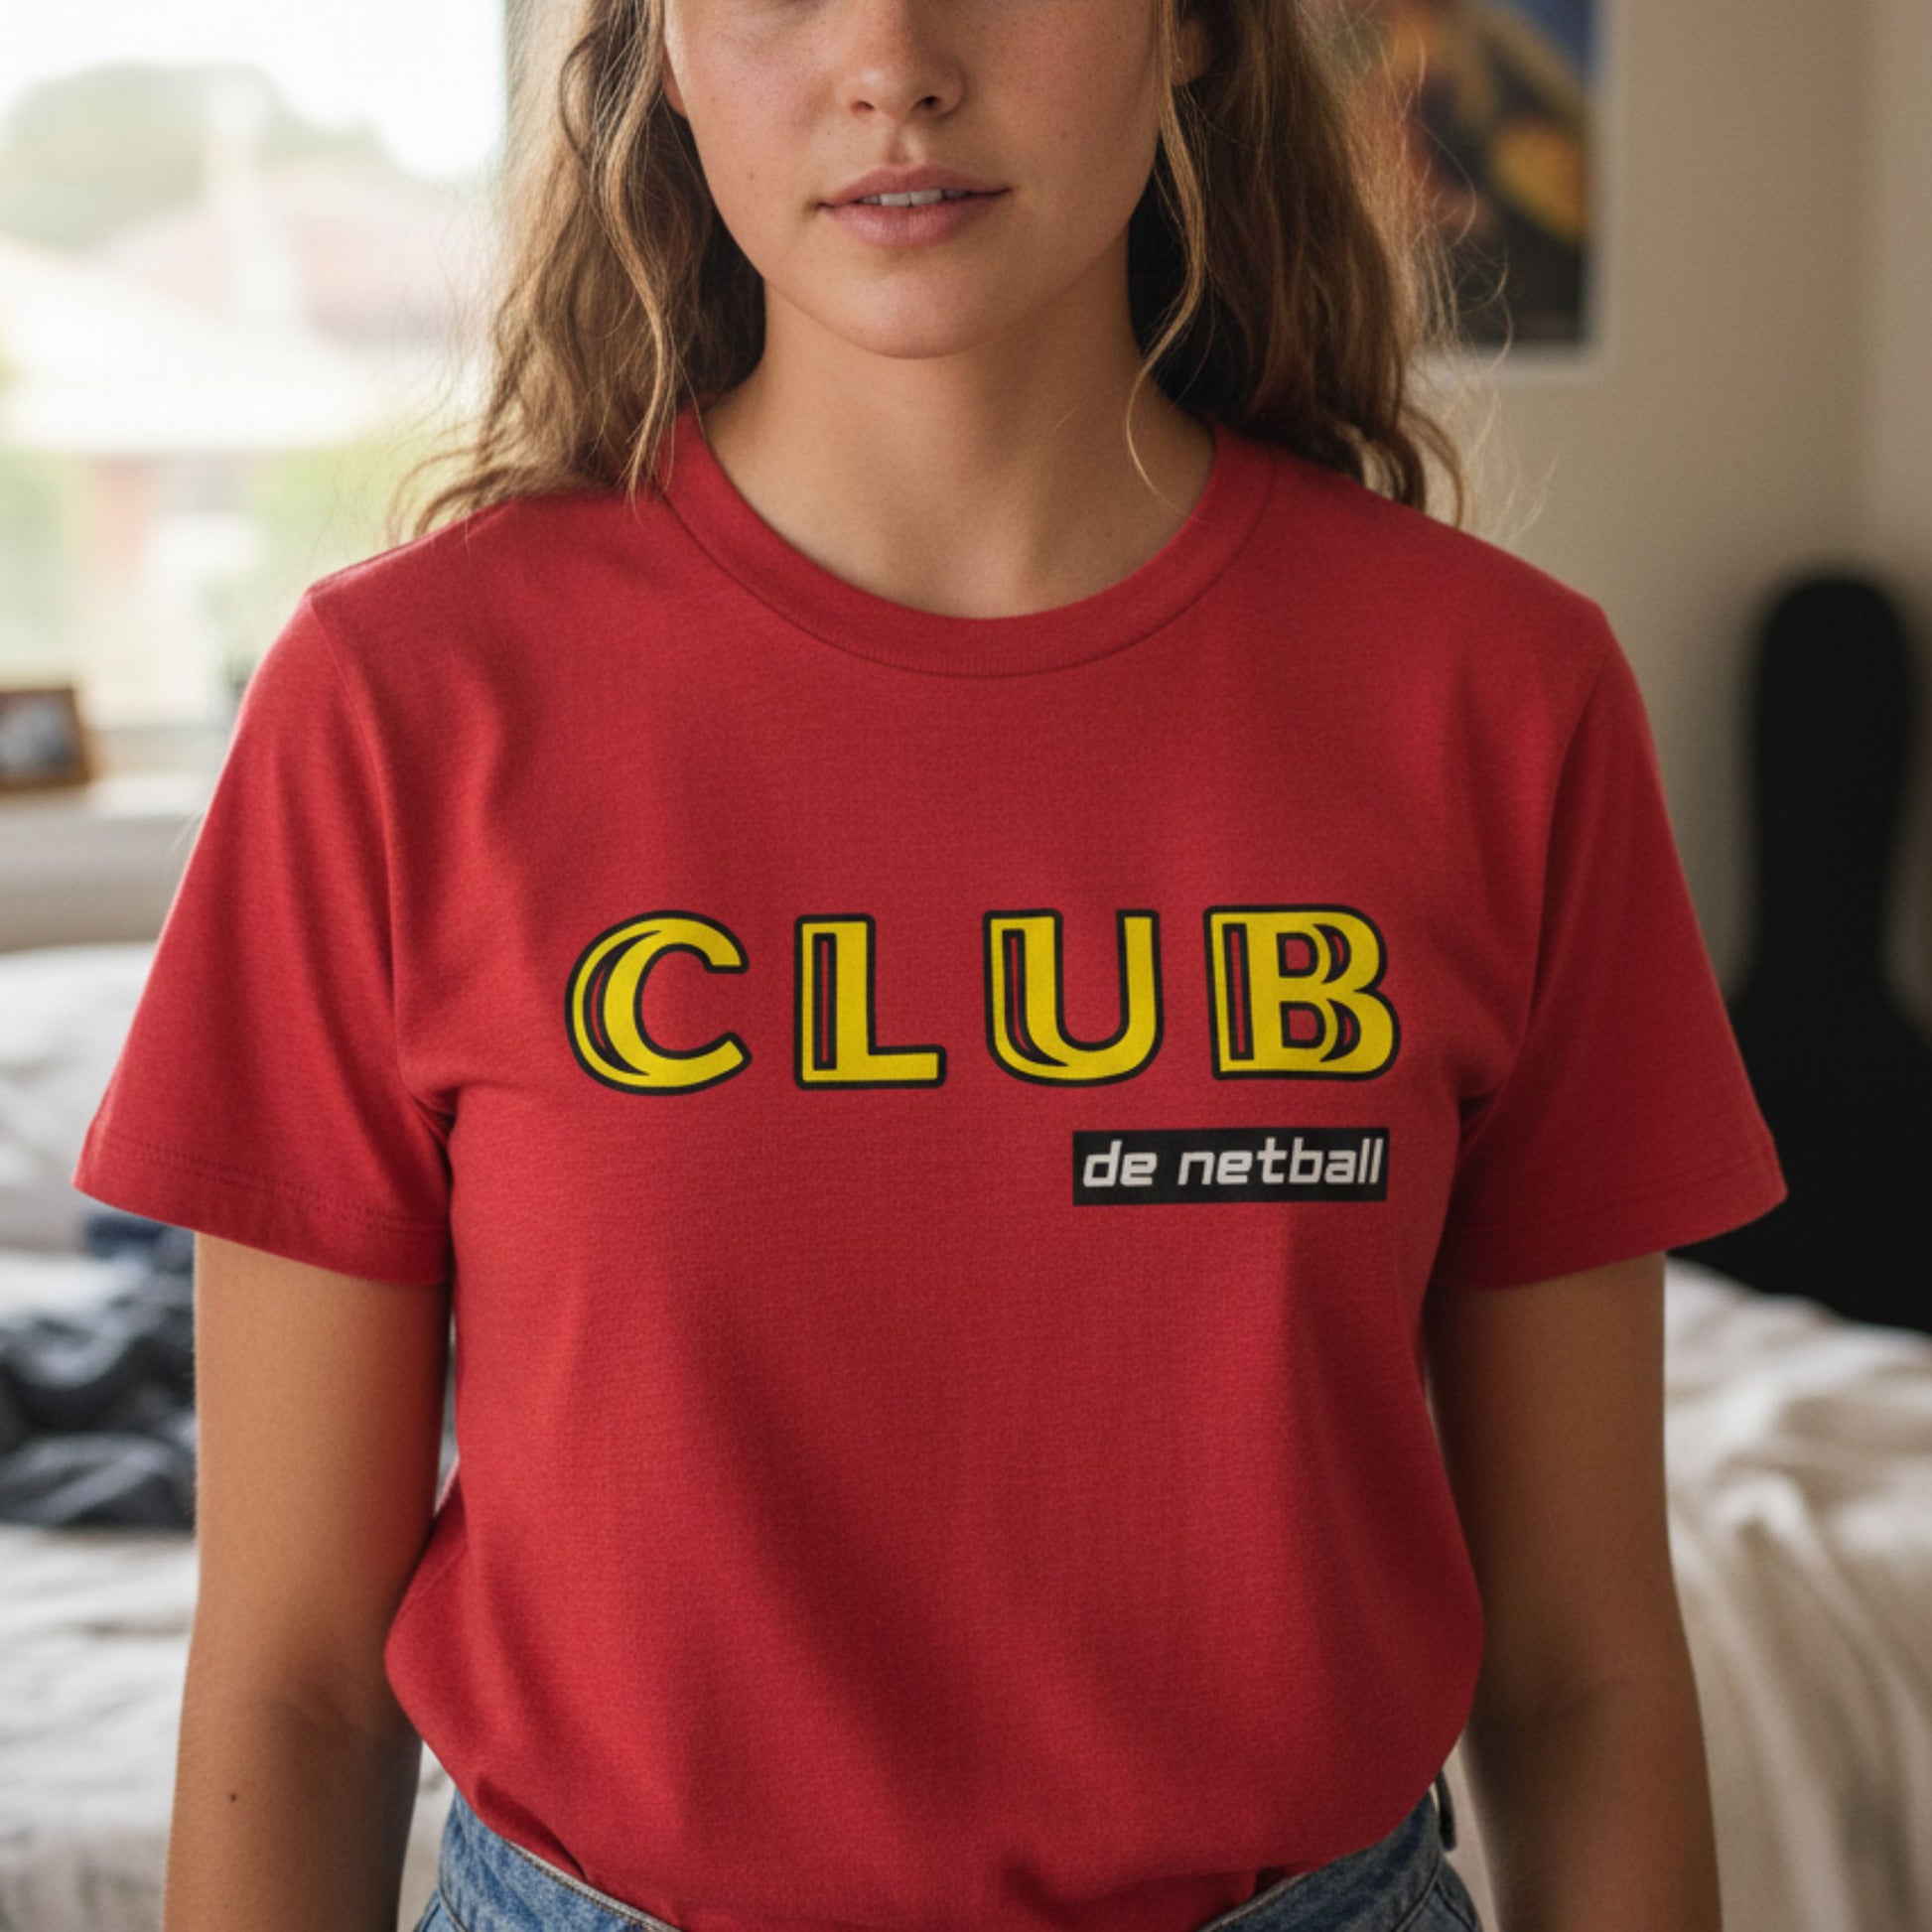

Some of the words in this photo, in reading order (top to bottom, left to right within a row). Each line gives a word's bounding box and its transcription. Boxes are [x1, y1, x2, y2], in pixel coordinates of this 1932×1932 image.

[565, 904, 1402, 1096] CLUB
[1082, 1140, 1159, 1187] de
[1177, 1137, 1384, 1186] netball
